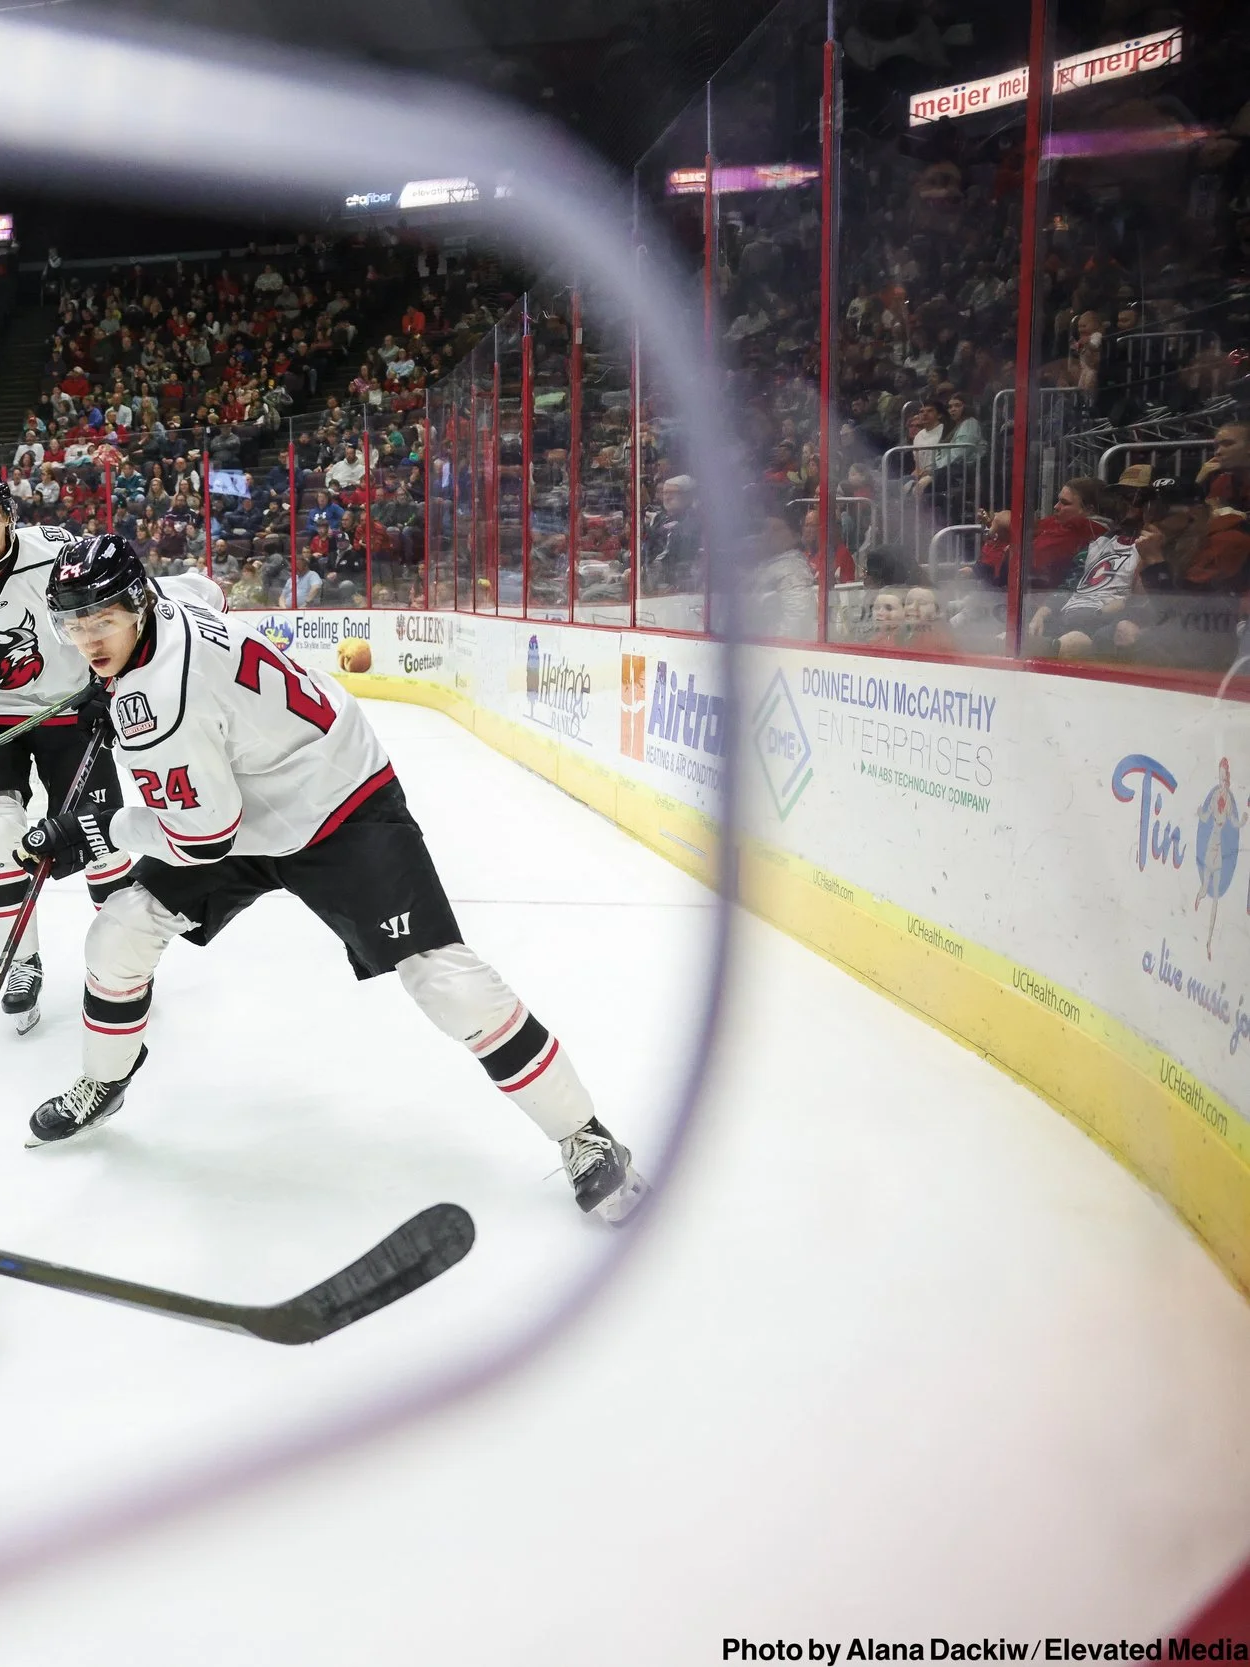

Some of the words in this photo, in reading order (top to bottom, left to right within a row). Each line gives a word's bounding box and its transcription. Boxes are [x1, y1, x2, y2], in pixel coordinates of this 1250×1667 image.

[915, 86, 990, 118] meijer
[1084, 40, 1173, 78] meijer
[59, 562, 84, 581] 24
[296, 617, 339, 643] Feeling
[343, 617, 370, 639] Good
[539, 653, 591, 722] Heritage
[647, 661, 727, 758] Airtro
[802, 667, 890, 712] DONNELLON
[893, 681, 996, 733] McCARTHY
[646, 744, 670, 771] HEATING
[675, 753, 687, 779] AIR
[687, 758, 720, 790] CONDITIO
[768, 726, 795, 761] DME
[817, 708, 994, 787] ENTERPRISES
[131, 764, 202, 810] 24
[867, 764, 878, 779] AN
[878, 767, 893, 784] ABS
[894, 770, 947, 800] TECHNOLOGY
[949, 787, 991, 814] COMPANY
[1112, 754, 1187, 872] Tin
[813, 869, 854, 903] UCHealth.com
[907, 915, 963, 959] UCHealth.com
[1012, 967, 1080, 1024] UCHealth.com
[1142, 949, 1155, 975] a
[1159, 938, 1183, 992] live
[1187, 976, 1230, 1025] music
[1160, 1058, 1228, 1137] UCHealth.com
